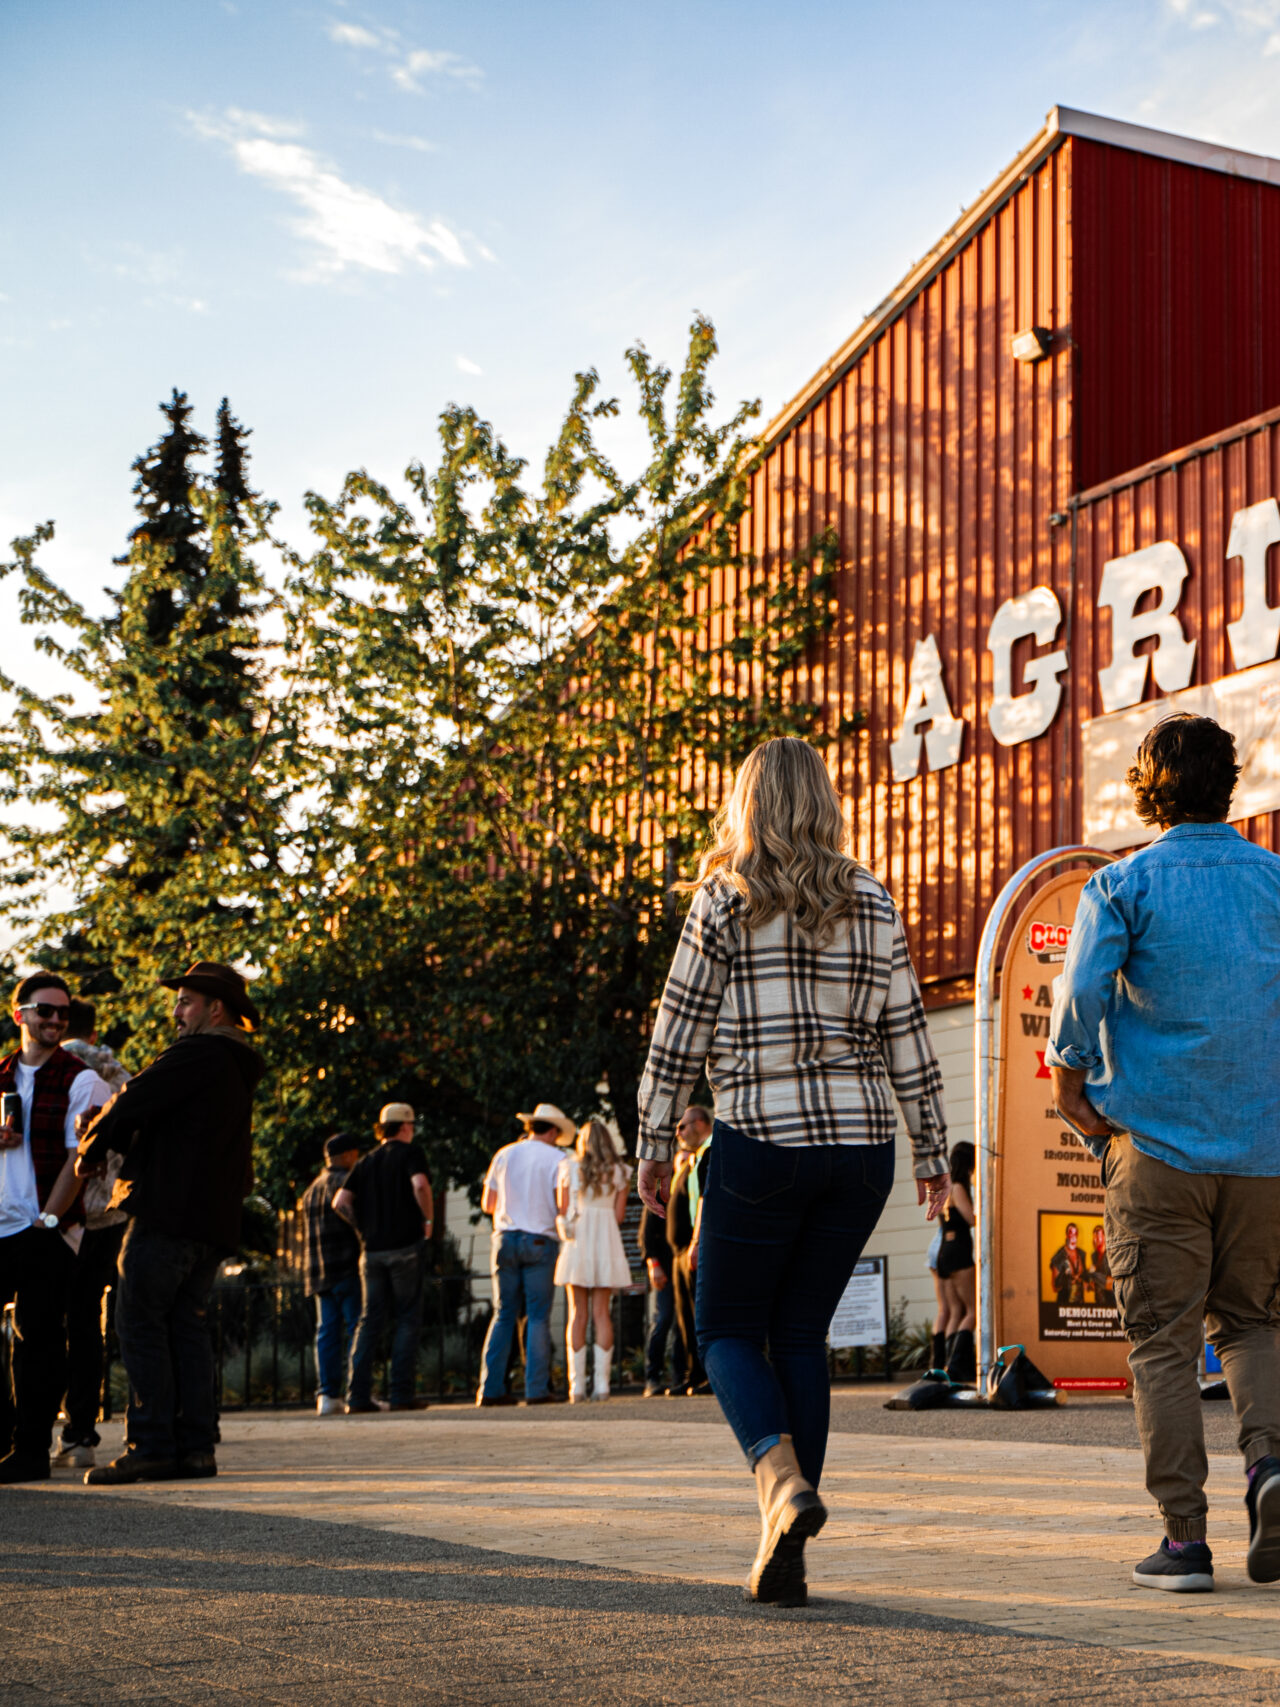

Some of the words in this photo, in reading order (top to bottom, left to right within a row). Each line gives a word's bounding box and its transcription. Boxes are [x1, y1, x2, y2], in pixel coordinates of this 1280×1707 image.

[1044, 1150, 1085, 1162] 12:00PM
[1057, 1172, 1104, 1189] MOND
[1059, 1307, 1118, 1318] DEMOLITION
